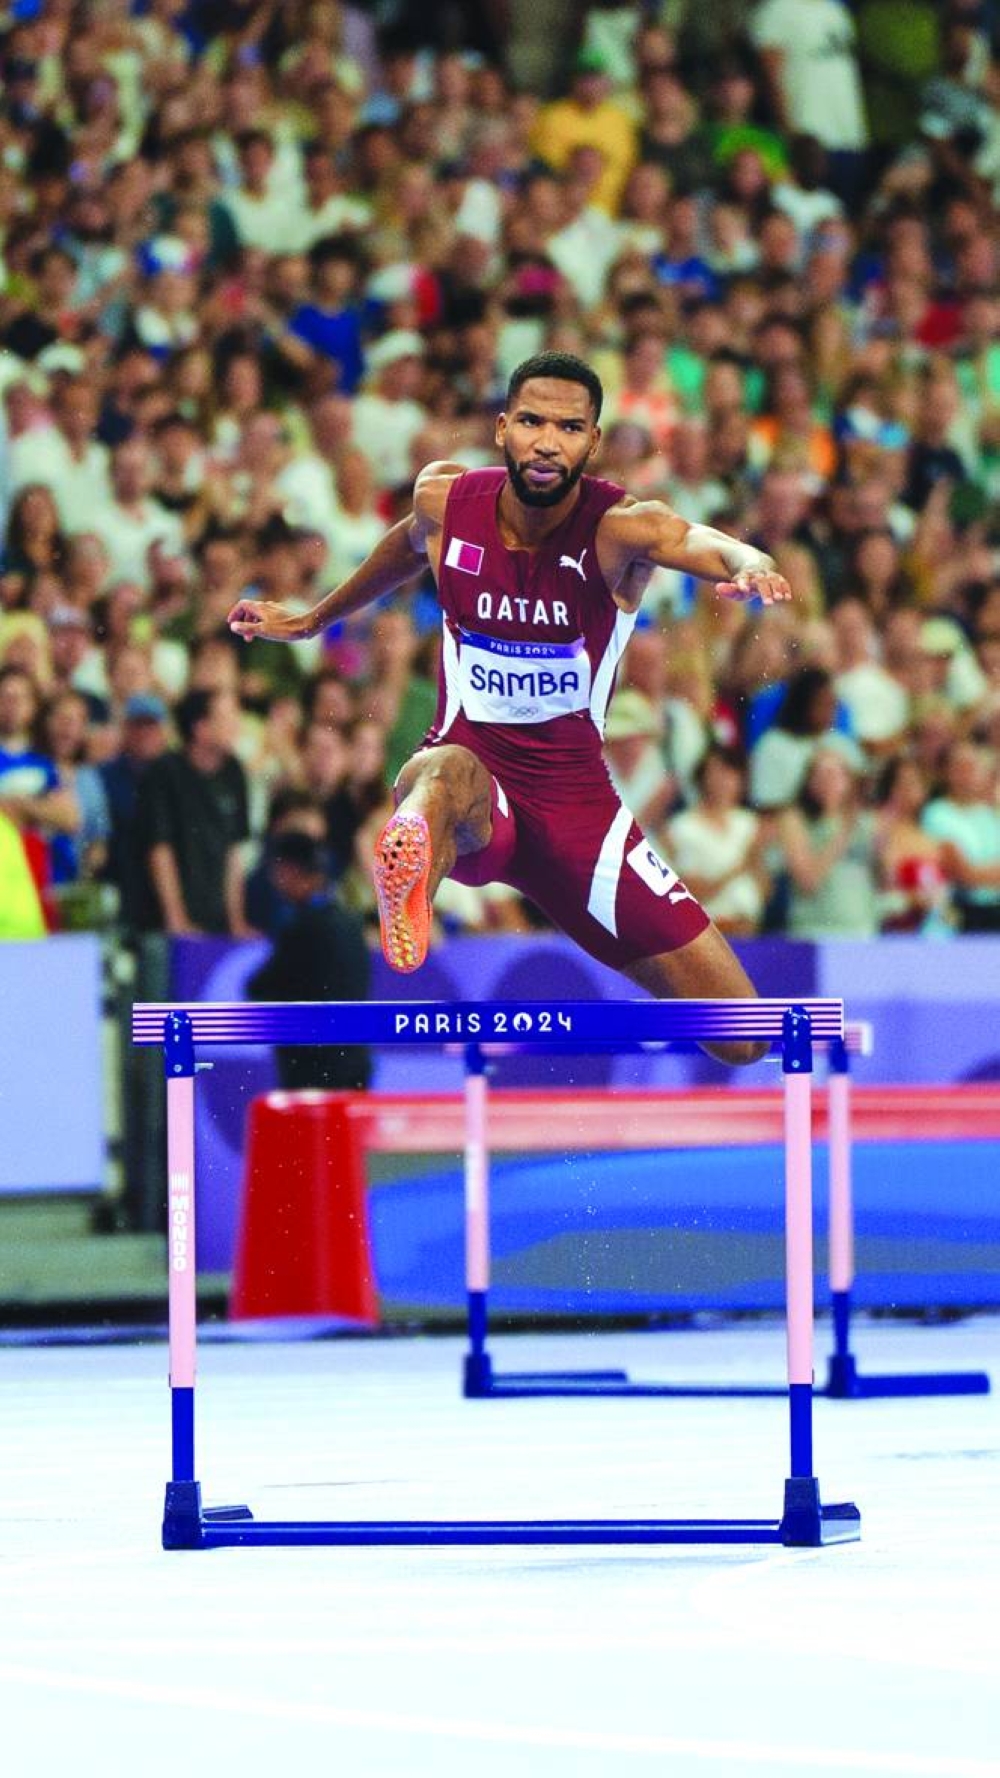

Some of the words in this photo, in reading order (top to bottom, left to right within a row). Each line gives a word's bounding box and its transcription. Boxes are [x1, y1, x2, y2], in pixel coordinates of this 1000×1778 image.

[477, 592, 569, 626] QATAR
[525, 646, 556, 654] 2024
[470, 664, 579, 697] SAMBA
[646, 850, 670, 878] 2
[493, 1011, 572, 1032] 2024
[171, 1195, 189, 1272] MONDO
